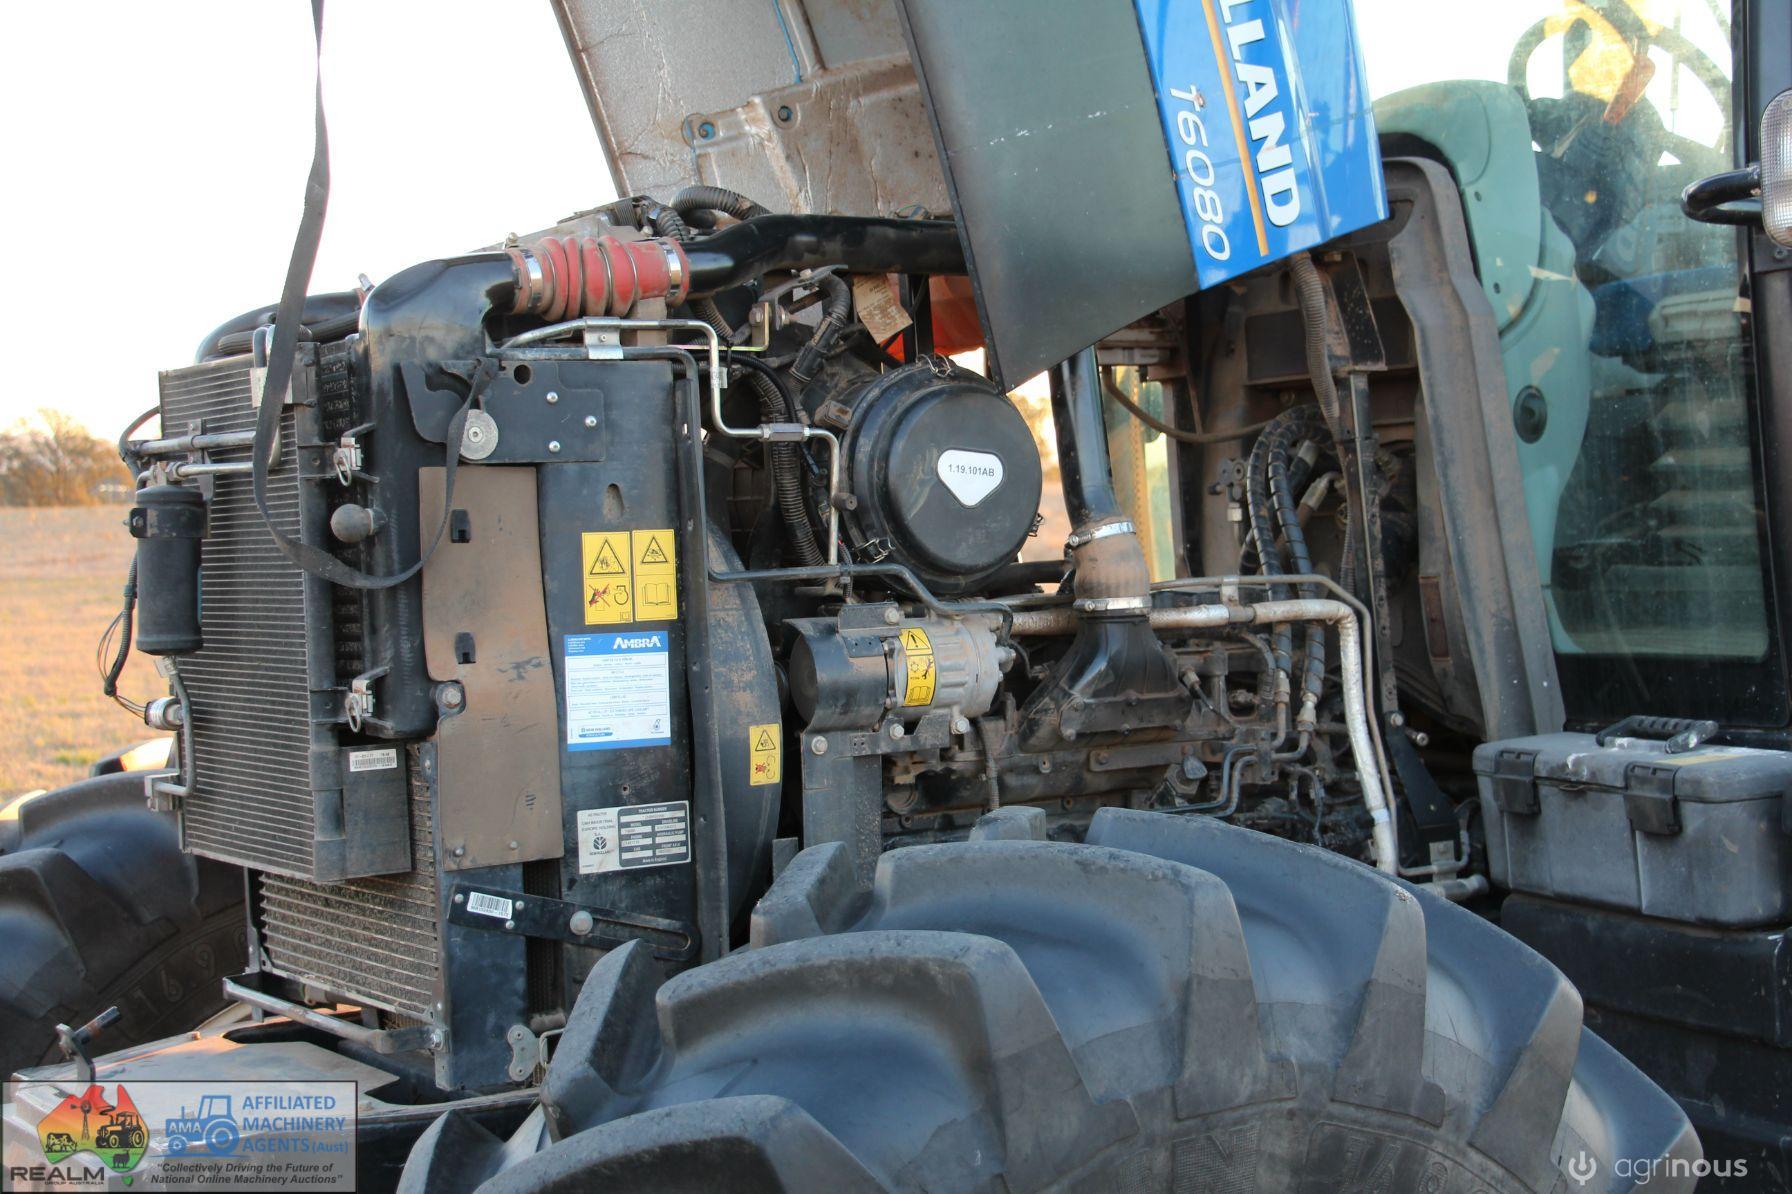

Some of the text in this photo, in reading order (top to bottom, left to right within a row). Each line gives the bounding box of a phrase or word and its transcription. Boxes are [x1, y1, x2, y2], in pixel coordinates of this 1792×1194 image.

[1170, 85, 1230, 260] T6080
[948, 463, 995, 477] 1.19.101AB
[613, 635, 661, 649] AMBRA
